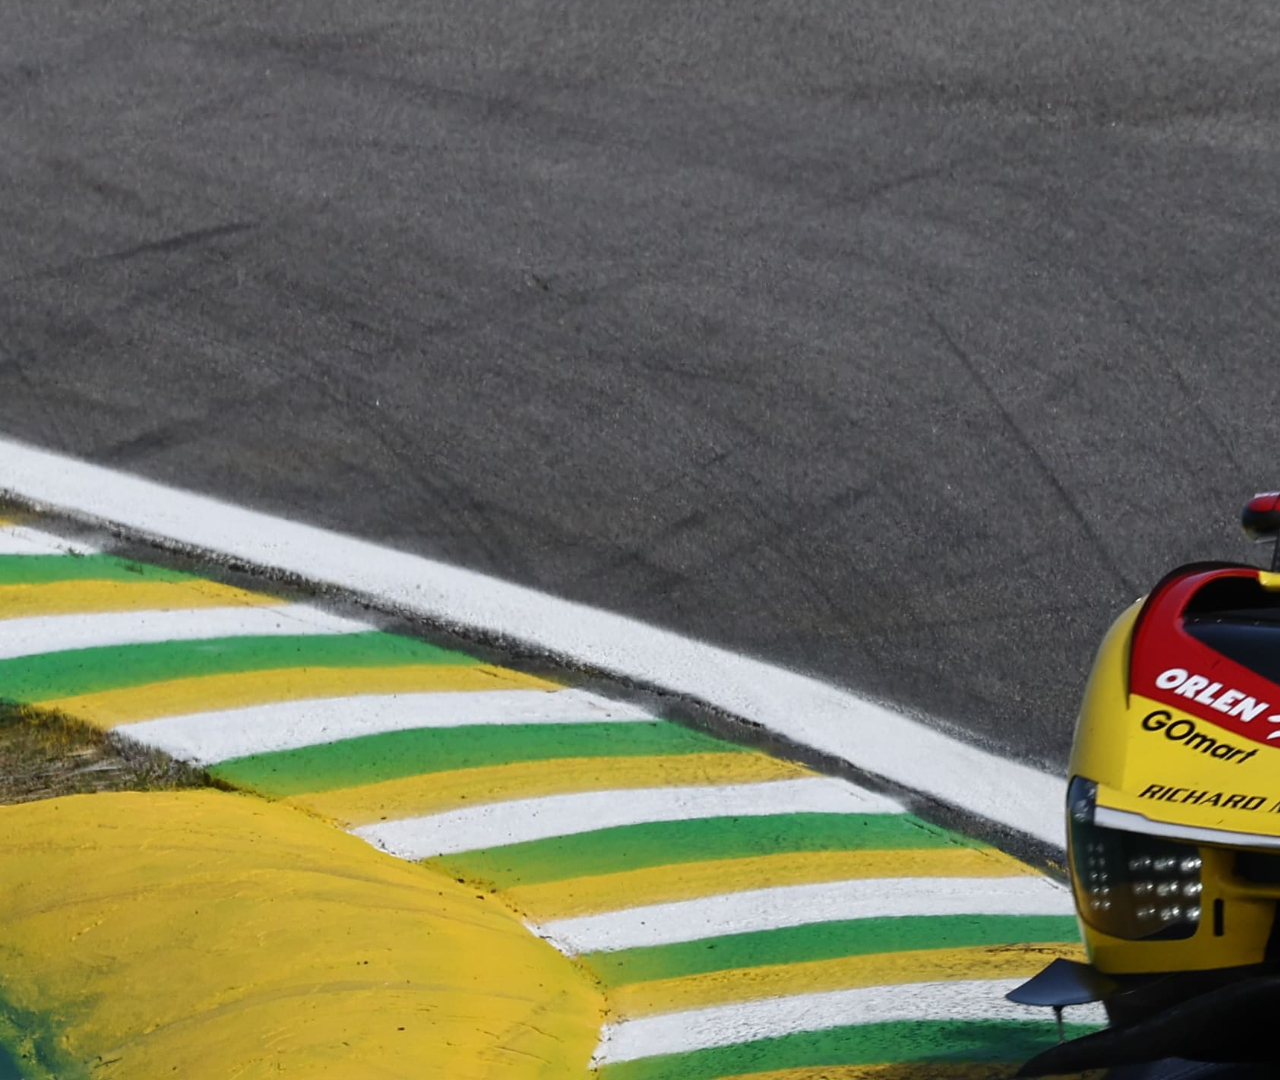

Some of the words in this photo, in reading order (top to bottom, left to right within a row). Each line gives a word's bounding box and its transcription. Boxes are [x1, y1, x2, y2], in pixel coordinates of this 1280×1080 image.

[1155, 668, 1270, 723] ORLEN
[1141, 710, 1259, 764] GOmart
[1138, 784, 1267, 812] RICHARD
